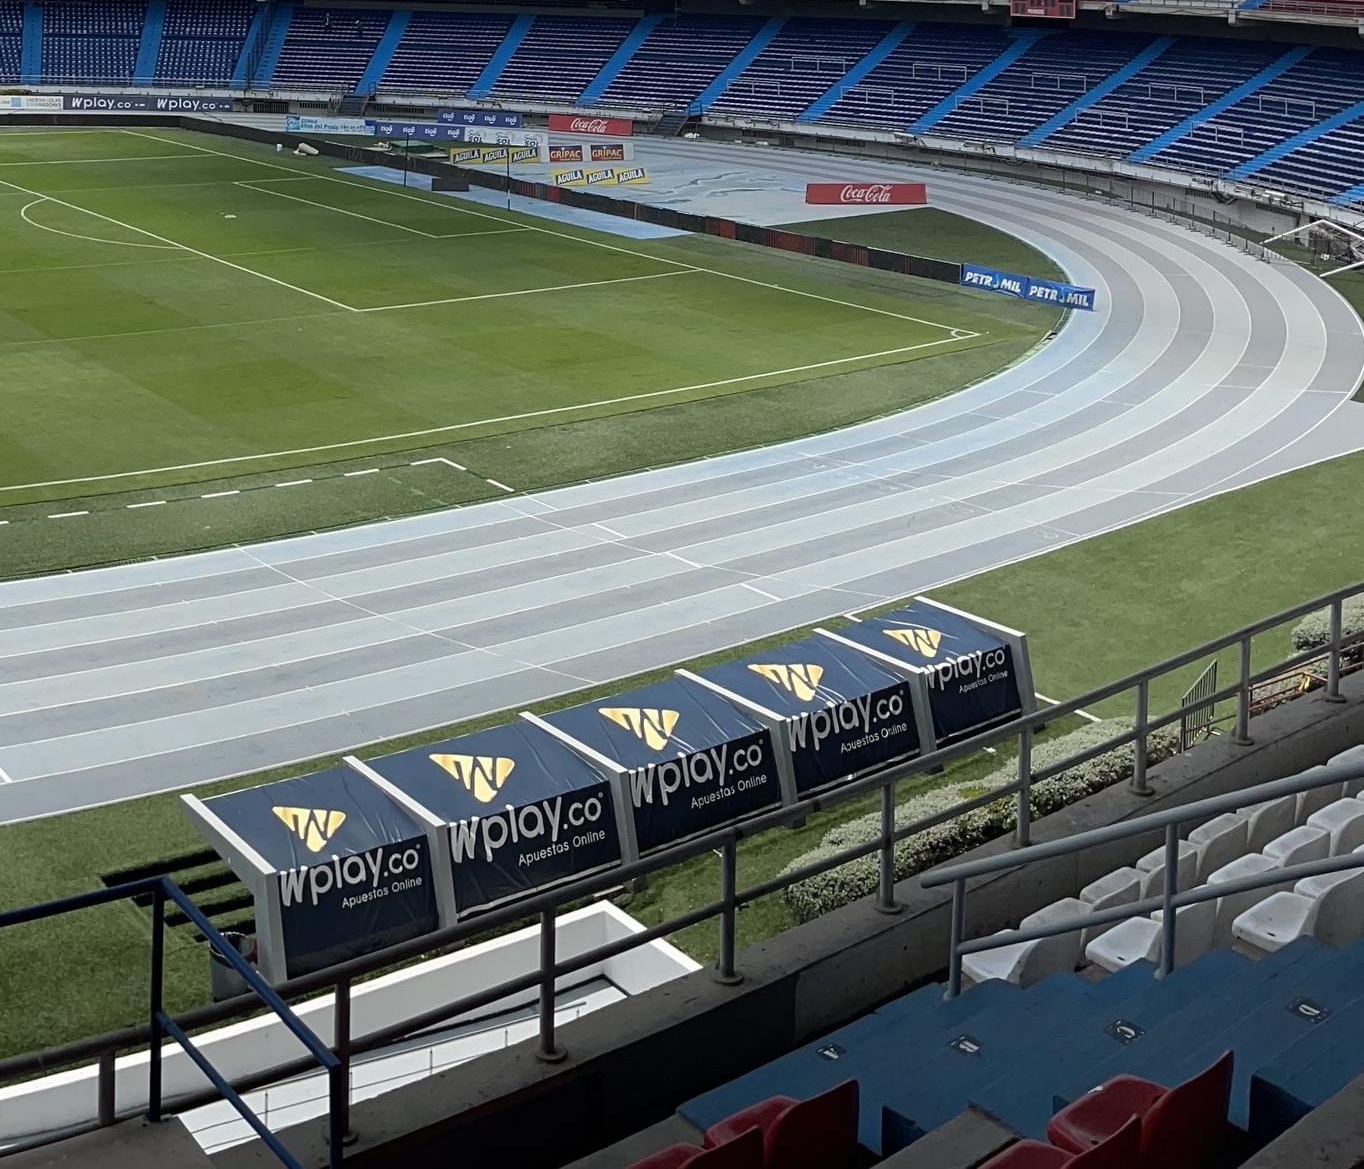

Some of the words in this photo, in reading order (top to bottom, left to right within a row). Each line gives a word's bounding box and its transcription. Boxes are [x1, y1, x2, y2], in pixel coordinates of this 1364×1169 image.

[550, 148, 581, 159] GRIPAC
[592, 147, 622, 158] GRIPAC
[988, 670, 1008, 683] Online
[881, 722, 907, 739] Online
[737, 773, 767, 792] Online
[572, 829, 606, 851] Online
[391, 876, 423, 895] Online
